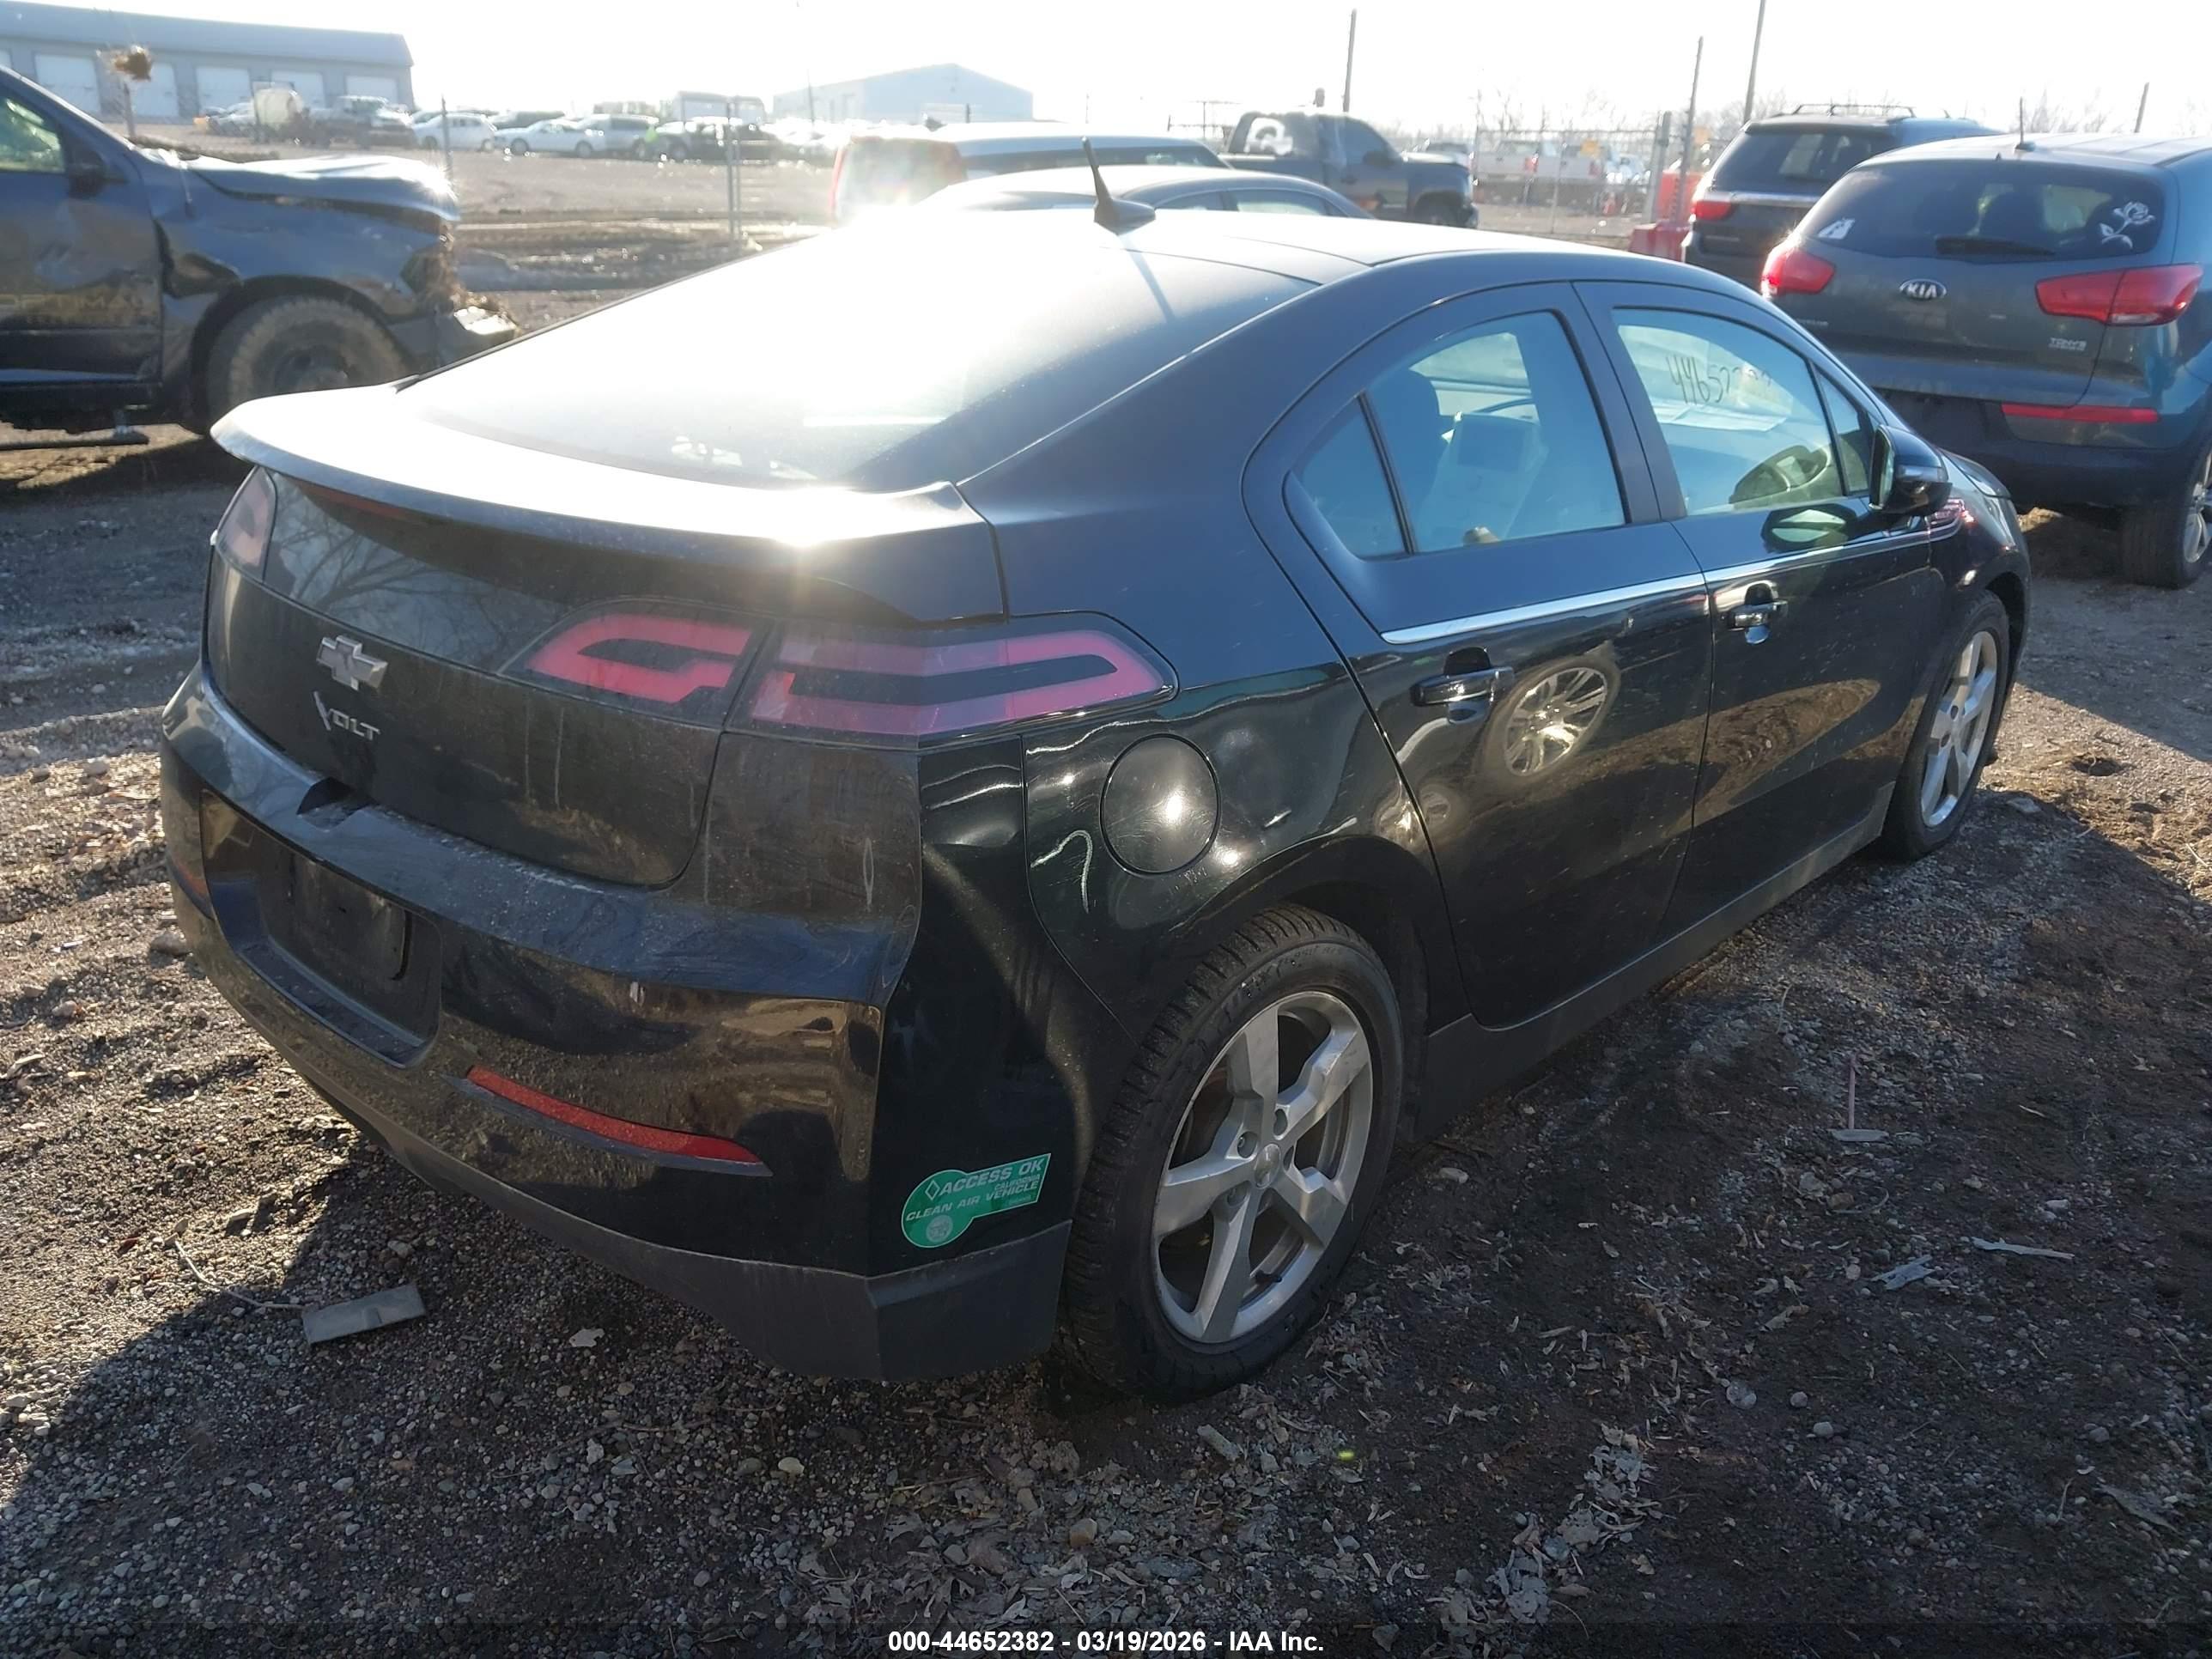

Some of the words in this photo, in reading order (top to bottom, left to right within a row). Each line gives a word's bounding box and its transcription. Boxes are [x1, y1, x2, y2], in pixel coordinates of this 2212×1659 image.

[1907, 283, 1937, 298] KIA
[313, 690, 380, 740] VOLT
[939, 1167, 1013, 1196] ACCESS
[1018, 1158, 1045, 1176] OK
[906, 1202, 952, 1221] CLEAN
[957, 1195, 980, 1209] AIR
[986, 1180, 1039, 1201] VEHICLE
